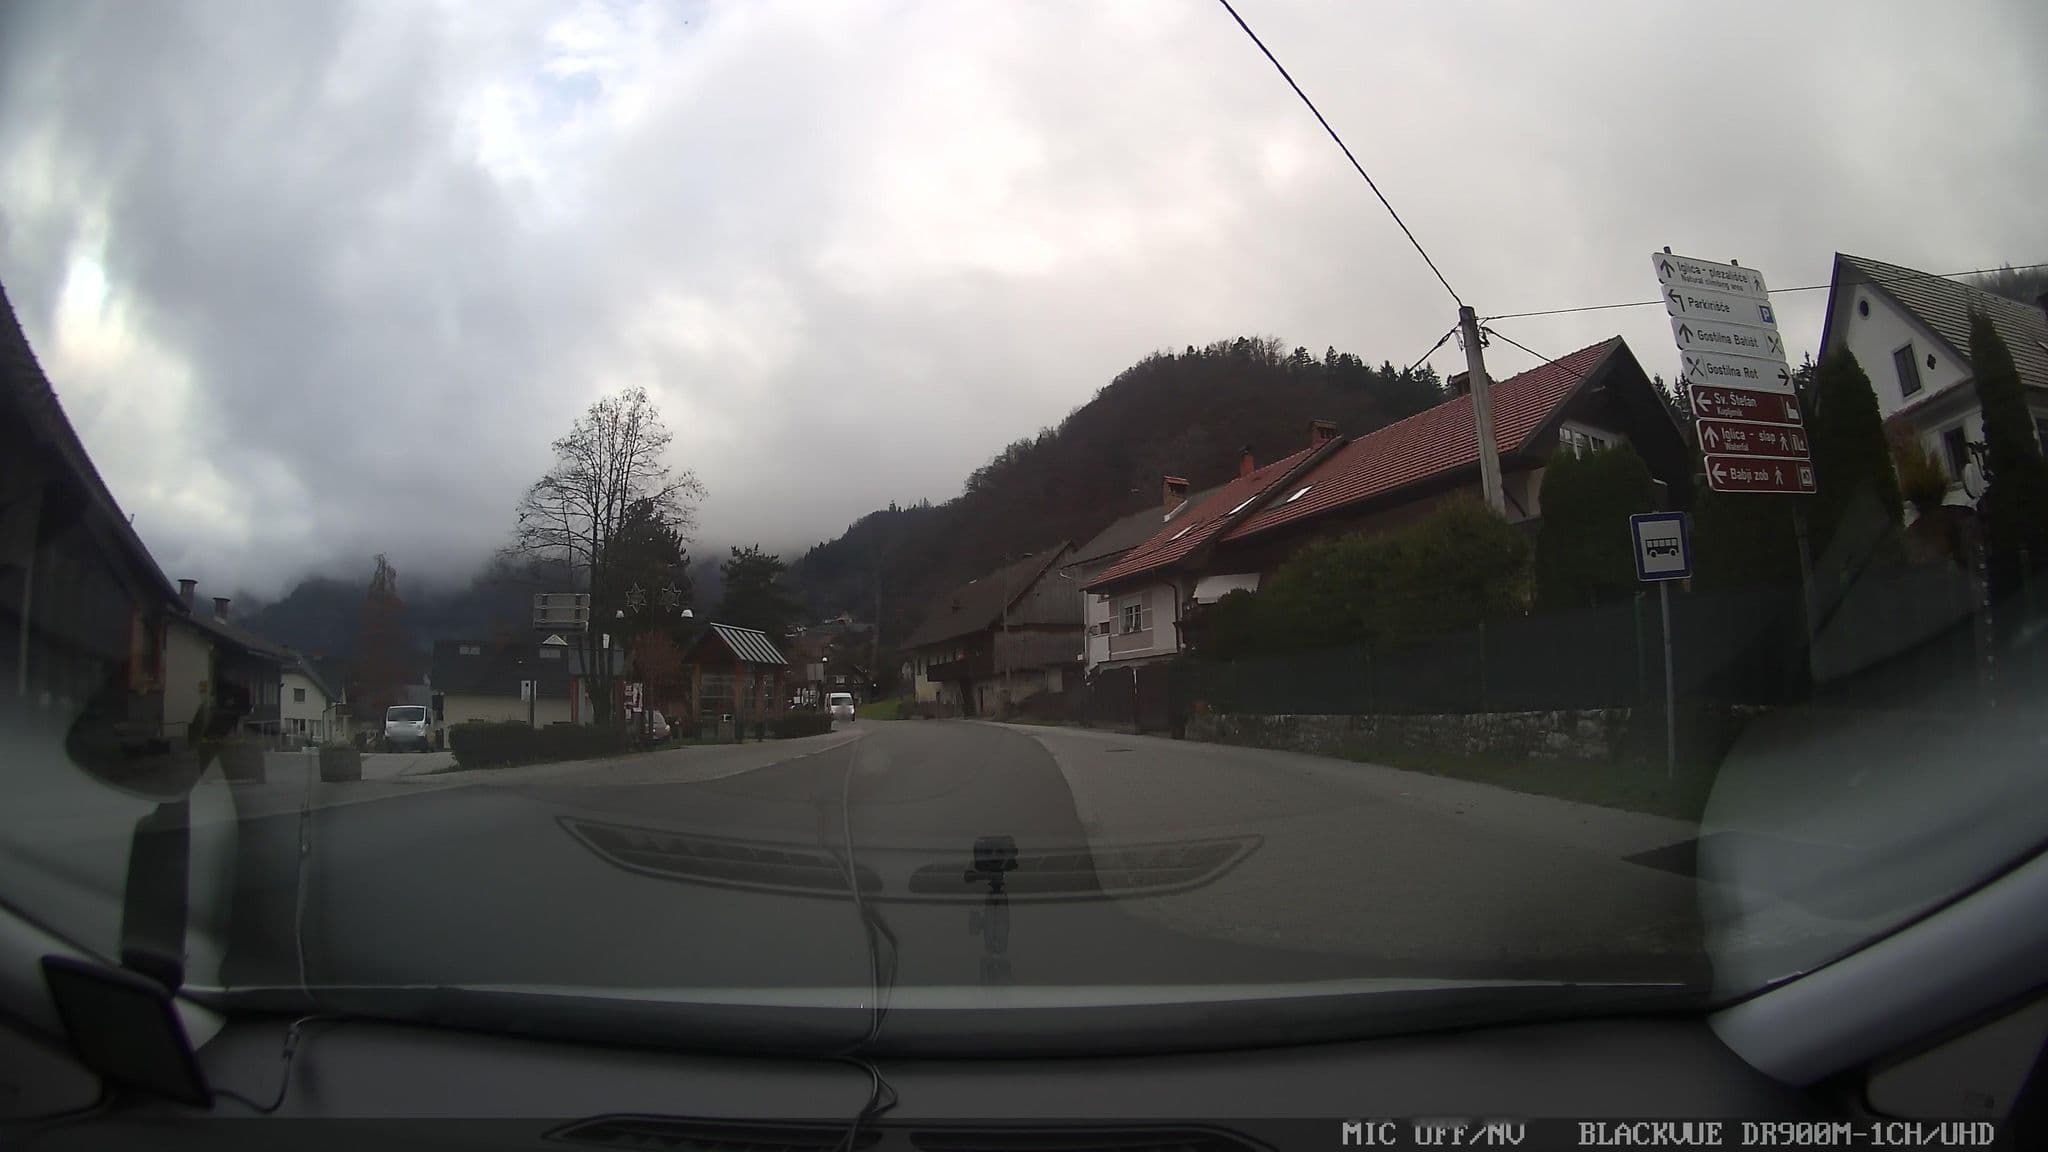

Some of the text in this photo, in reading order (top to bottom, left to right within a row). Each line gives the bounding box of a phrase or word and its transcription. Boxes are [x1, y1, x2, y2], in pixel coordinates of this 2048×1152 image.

[1697, 329, 1732, 345] Gostilna
[1706, 362, 1759, 379] Gostilna Rot
[1713, 392, 1757, 407] Sv. Štefan
[1721, 427, 1746, 441] Iglica
[1758, 431, 1776, 444] slap
[1729, 467, 1769, 483] Babji zob
